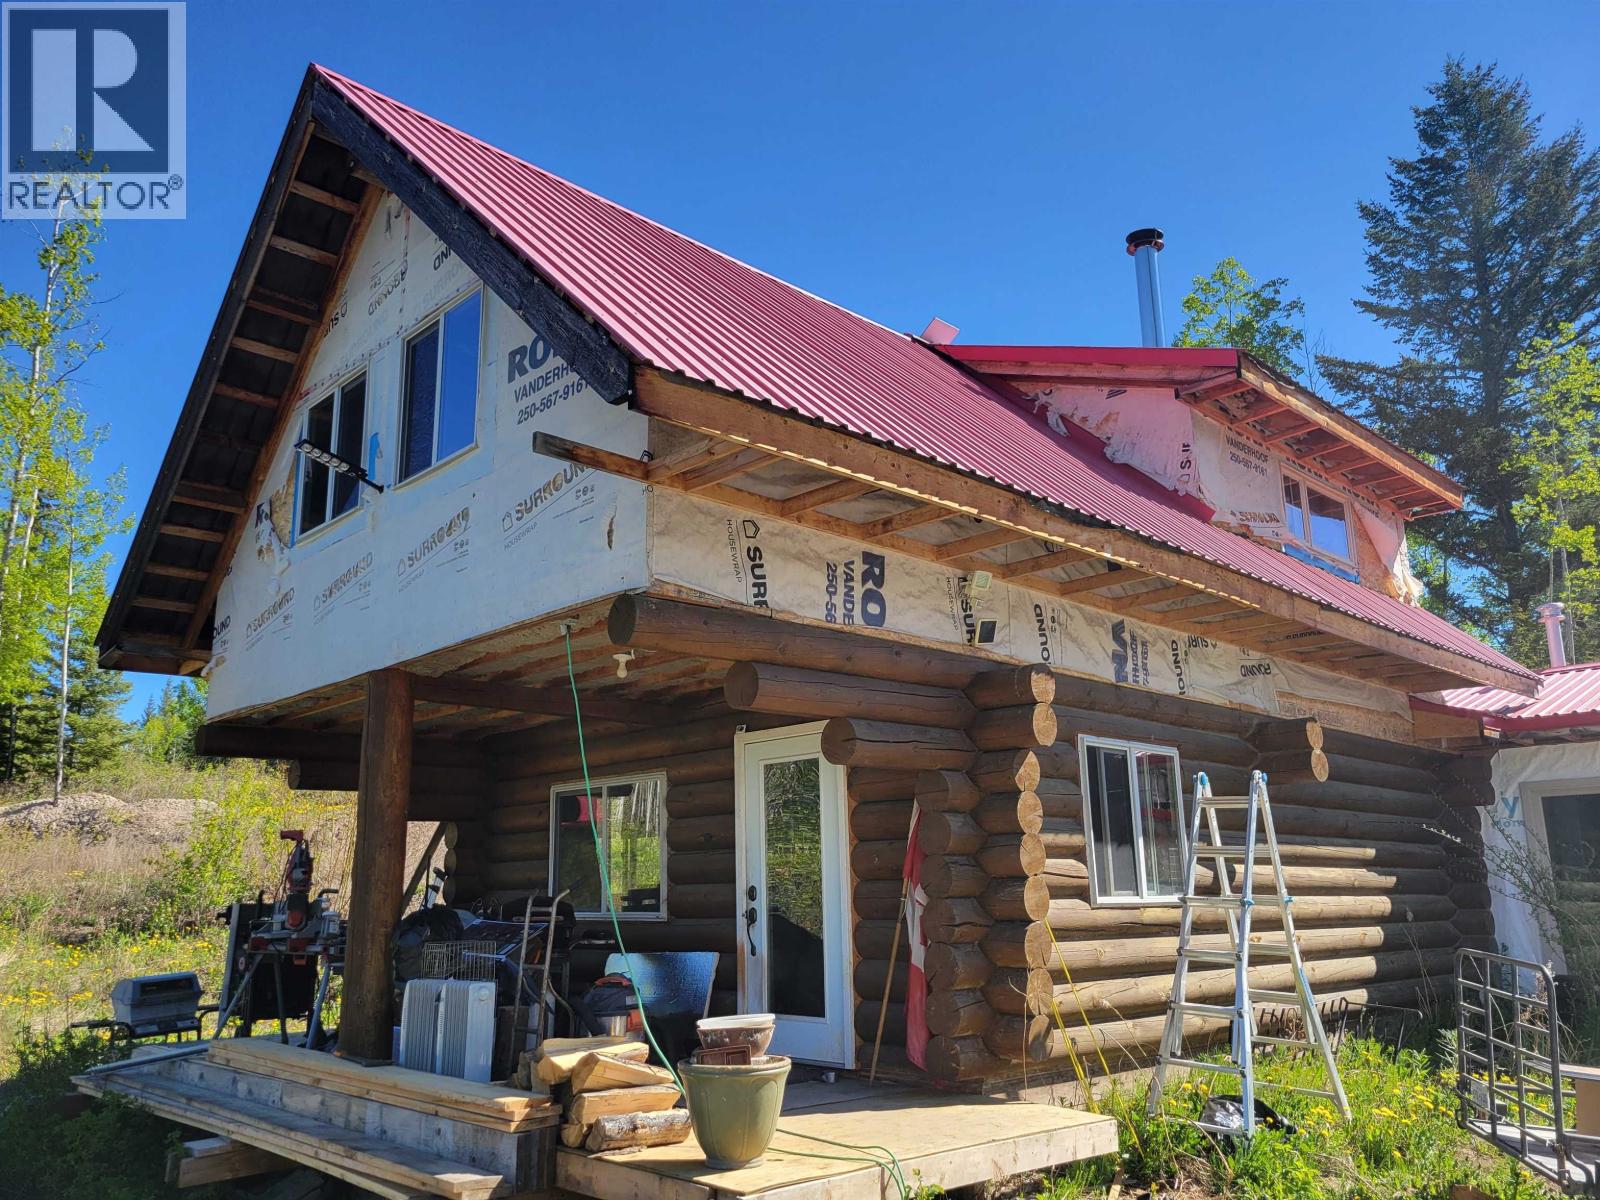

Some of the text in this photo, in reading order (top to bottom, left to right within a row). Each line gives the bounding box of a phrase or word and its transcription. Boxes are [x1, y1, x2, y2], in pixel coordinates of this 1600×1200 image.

[507, 335, 557, 384] RO
[514, 464, 588, 522] SURROUN
[726, 519, 743, 584] HOUSEWRAP
